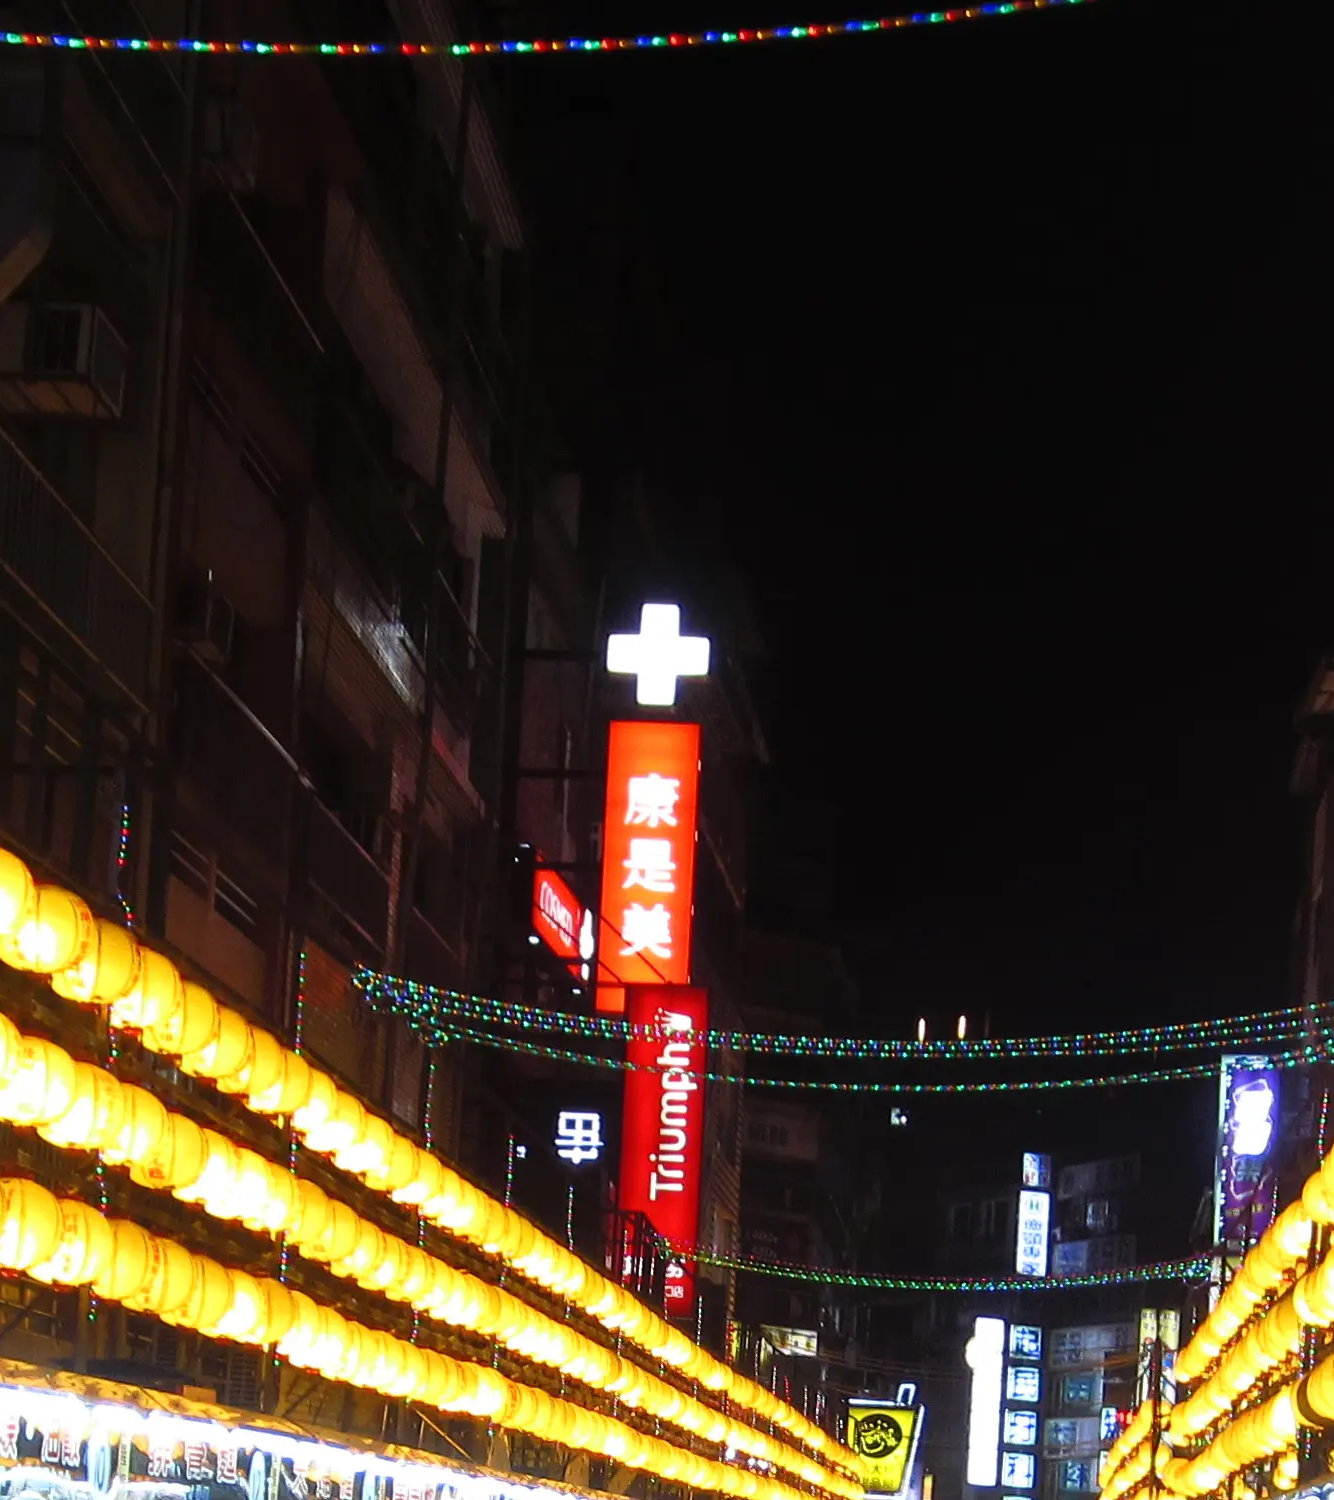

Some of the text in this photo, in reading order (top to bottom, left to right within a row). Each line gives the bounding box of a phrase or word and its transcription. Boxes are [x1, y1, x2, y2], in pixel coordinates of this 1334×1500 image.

[620, 773, 681, 960] 康是美
[649, 1036, 698, 1201] Triumph
